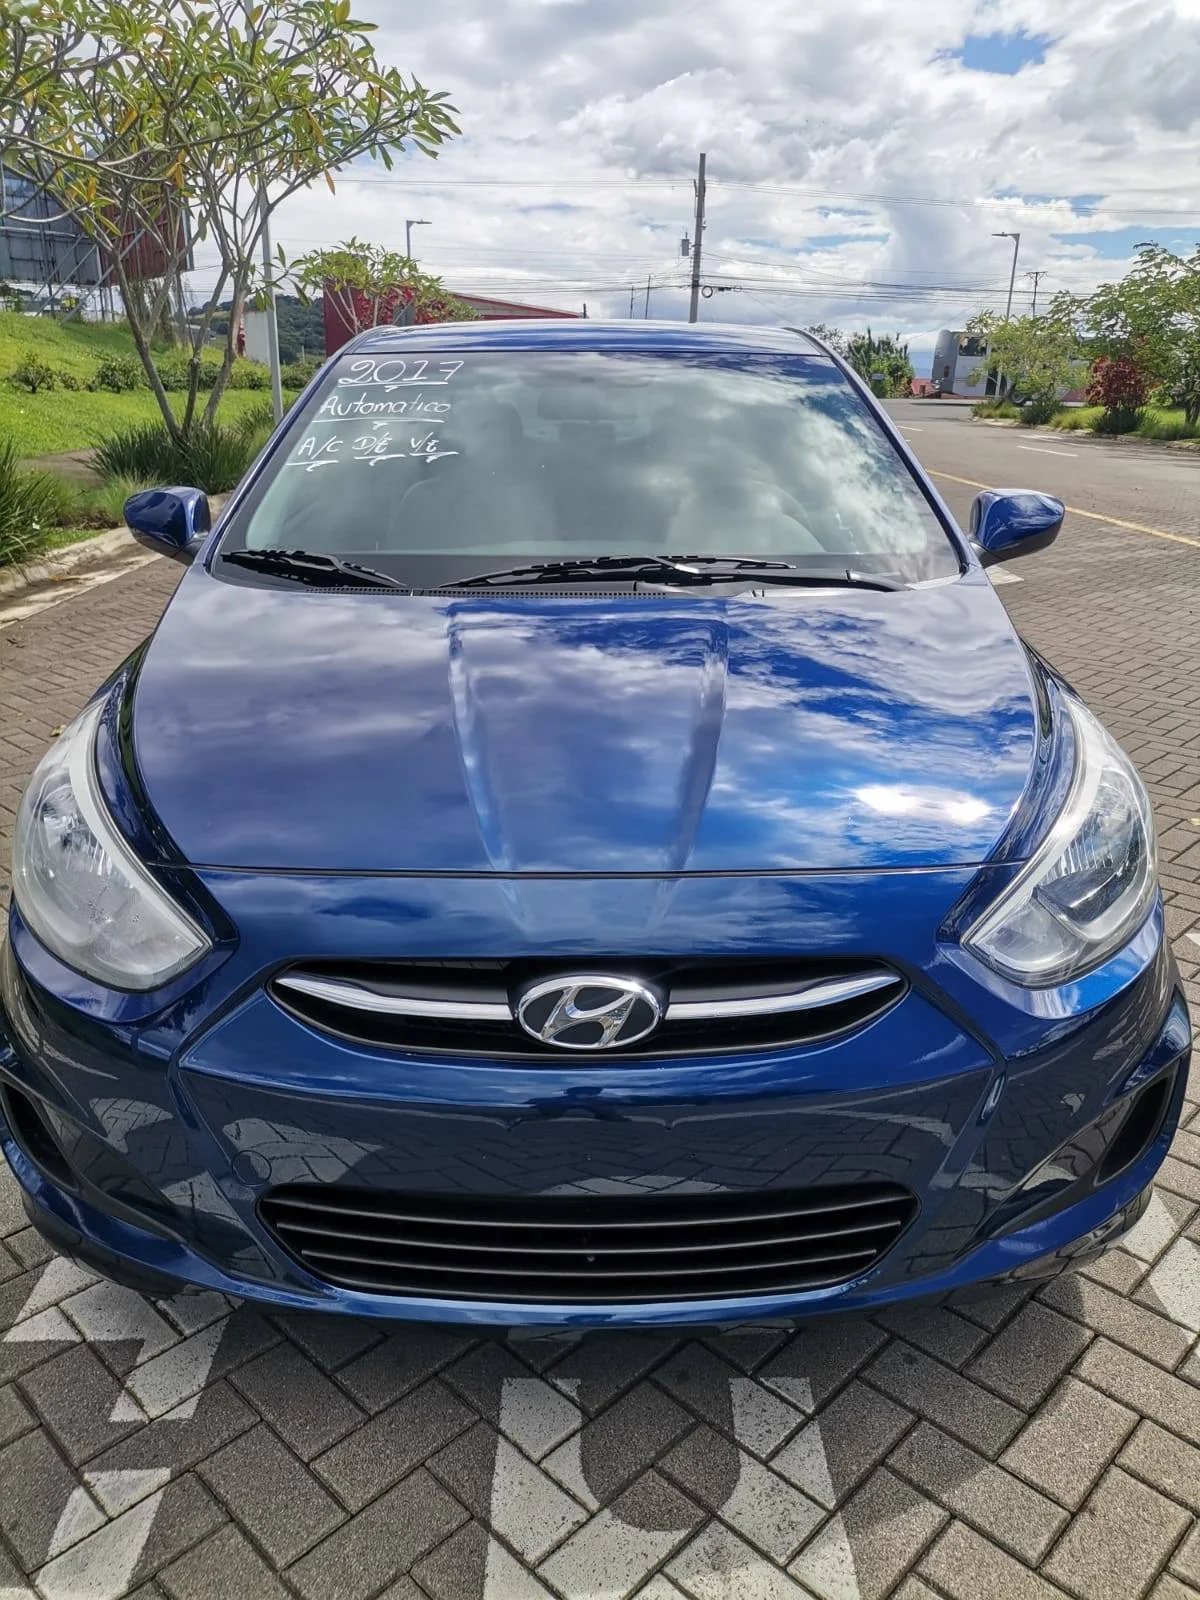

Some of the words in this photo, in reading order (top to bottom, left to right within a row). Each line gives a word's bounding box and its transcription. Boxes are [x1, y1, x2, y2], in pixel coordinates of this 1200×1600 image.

[338, 359, 465, 385] 2017
[319, 392, 451, 415] Automatico
[297, 435, 344, 460] A/C
